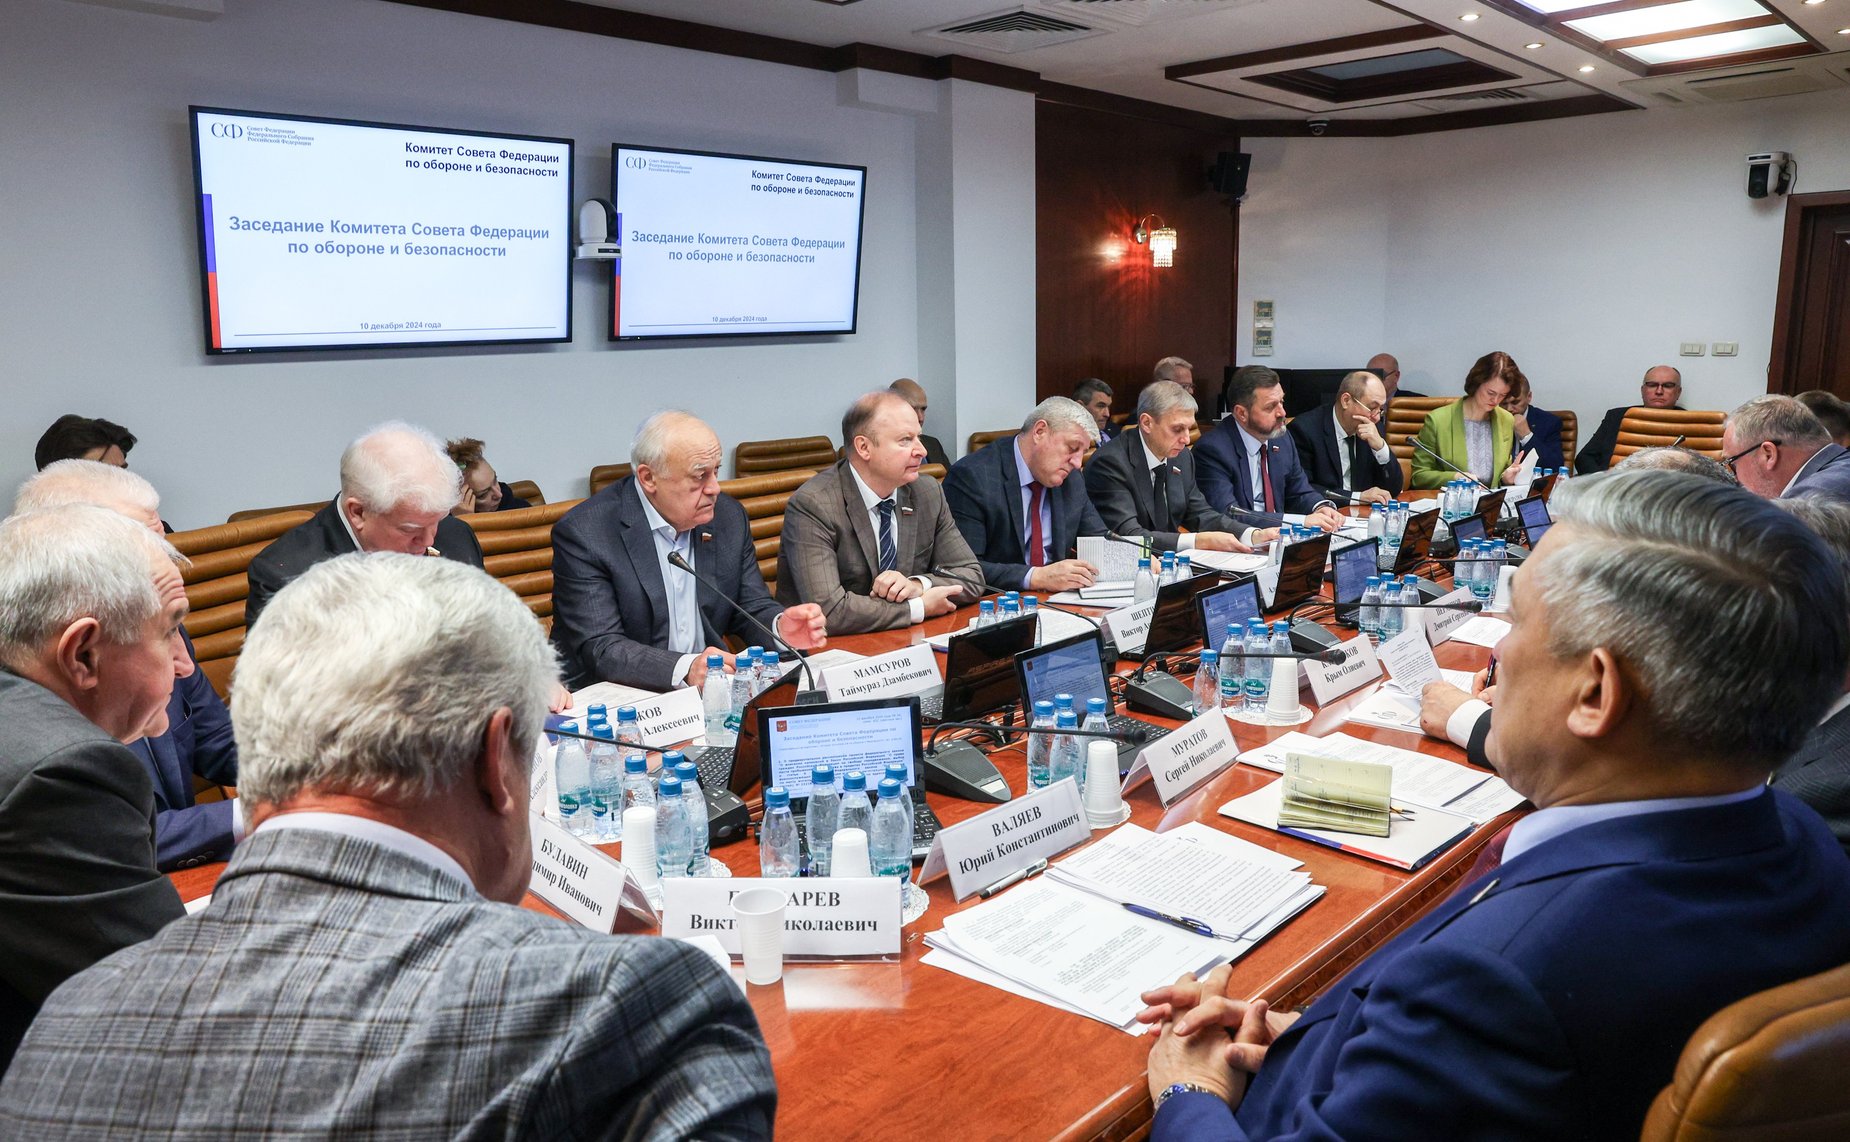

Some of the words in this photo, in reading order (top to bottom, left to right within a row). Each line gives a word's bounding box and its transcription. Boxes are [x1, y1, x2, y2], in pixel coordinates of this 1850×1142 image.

[211, 122, 243, 139] СФ
[405, 141, 453, 155] Комитет
[456, 146, 496, 159] Совета
[499, 149, 560, 164] Федерации
[405, 159, 420, 168] по
[423, 159, 473, 172] обороне
[475, 164, 482, 172] и
[485, 163, 559, 177] безопасности
[751, 169, 784, 181] Комитет
[786, 172, 813, 183] Совета
[814, 176, 856, 187] Федерации
[763, 183, 796, 194] обороне
[804, 186, 854, 198] безопасности
[229, 216, 324, 234] Заседание
[330, 219, 406, 235] Комитета
[412, 222, 465, 237] Совета
[470, 224, 549, 240] Федерации
[288, 243, 309, 253] по
[314, 240, 385, 257] обороне
[390, 245, 399, 255] и
[404, 242, 506, 256] безопасности
[632, 230, 694, 244] Заседание
[698, 233, 748, 245] Комитета
[752, 235, 788, 246] Совета
[791, 237, 845, 250] Федерации
[668, 251, 682, 260] по
[686, 250, 733, 263] обороне
[746, 251, 815, 263] безопасности
[360, 322, 369, 330] 10
[370, 322, 404, 330] декабря
[405, 321, 423, 329] 2024
[424, 321, 442, 329] года
[1130, 606, 1155, 621] ШЕПТ
[1120, 625, 1143, 638] Виктор
[853, 657, 911, 679] МАМСУРОВ
[1324, 668, 1343, 683] Крым
[838, 682, 881, 697] Таймураз
[882, 668, 932, 688] Дзамбекович
[643, 713, 700, 737] Алексеевич
[1171, 728, 1208, 758] МУРАТОВ
[1165, 760, 1191, 783] Сергей
[1188, 738, 1227, 768] Николаевич
[991, 805, 1042, 837] ВАЛЯЕВ
[959, 849, 995, 874] Юрий
[996, 813, 1080, 858] Константинович
[541, 838, 589, 880] БУЛАВИН
[557, 874, 603, 916] Иванович
[690, 914, 739, 930] Викт
[783, 920, 878, 932] иколаевич
